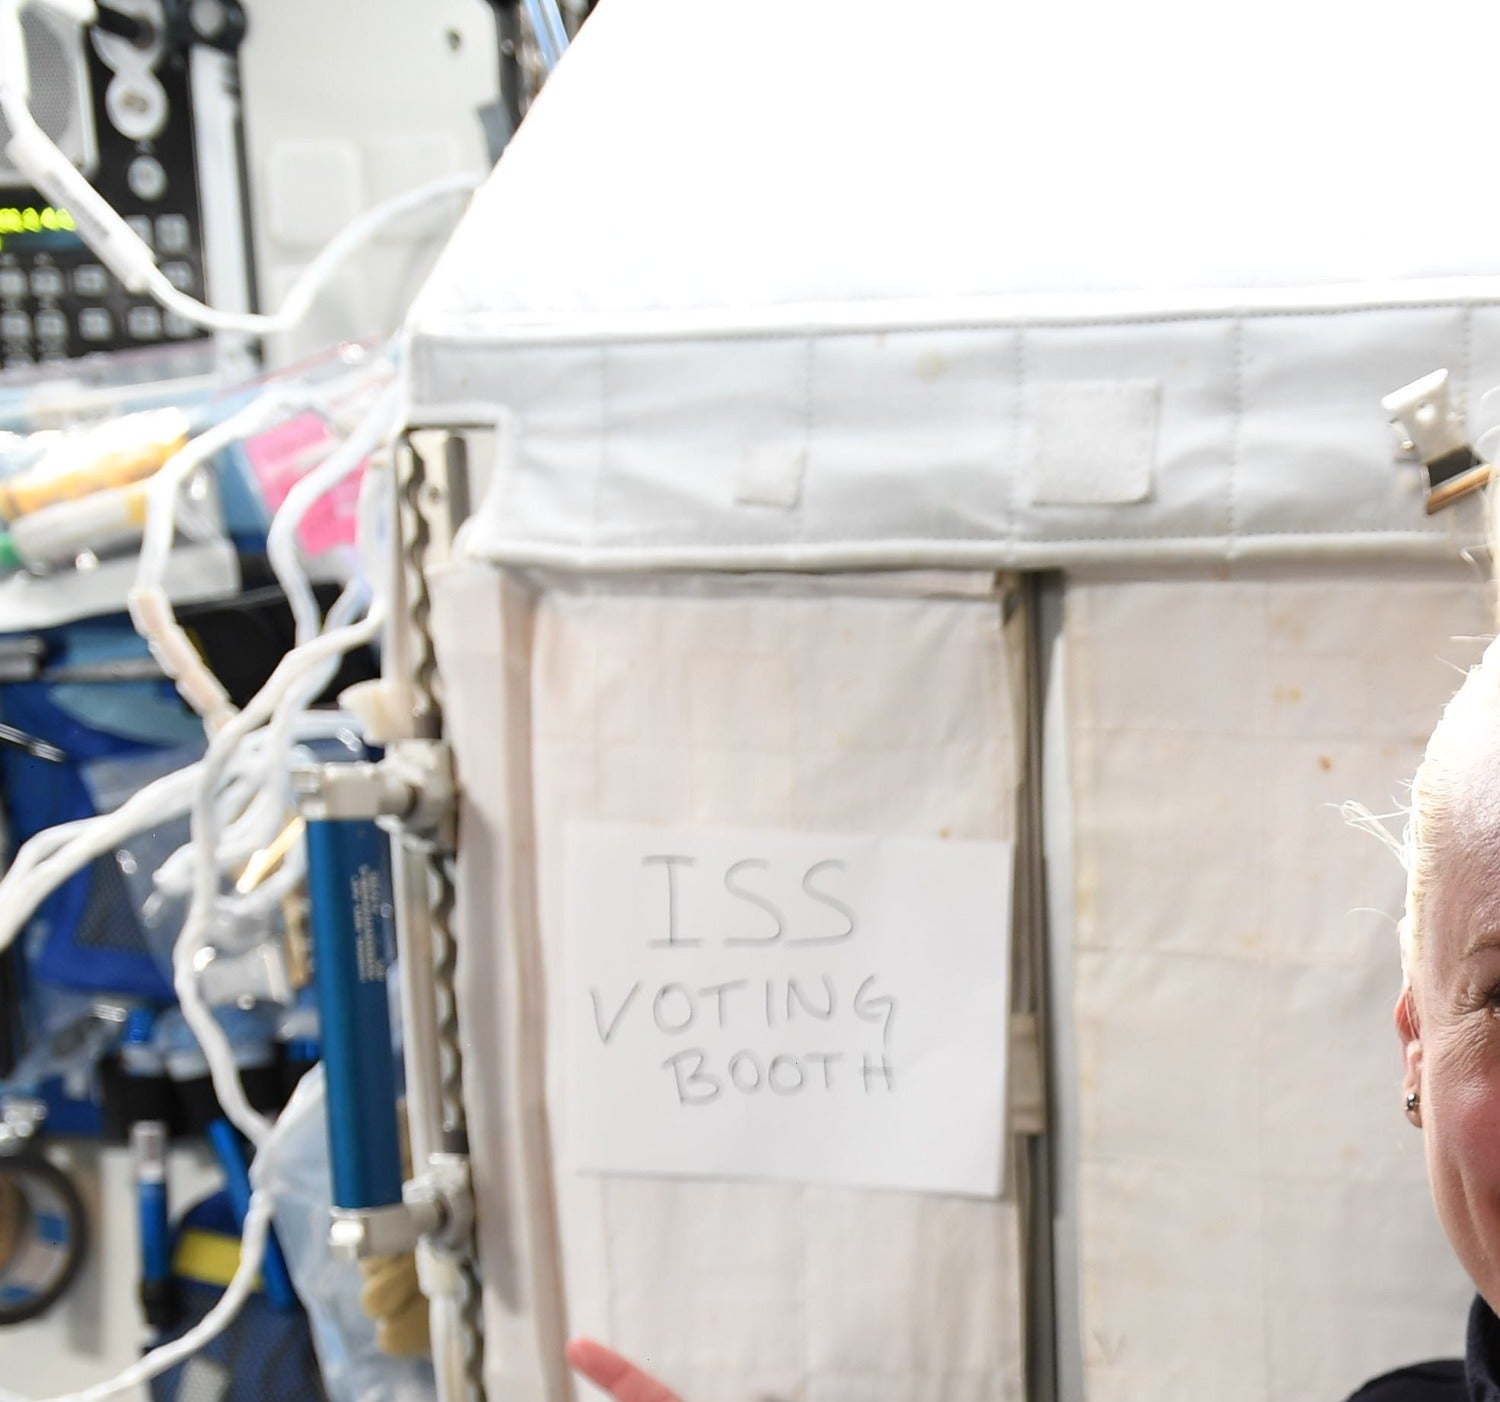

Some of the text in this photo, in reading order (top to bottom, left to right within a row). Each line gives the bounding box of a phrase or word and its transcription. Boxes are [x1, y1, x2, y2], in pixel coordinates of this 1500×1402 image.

[641, 854, 857, 948] ISS
[589, 974, 897, 1048] VOTING
[661, 1048, 894, 1106] BOOTH
